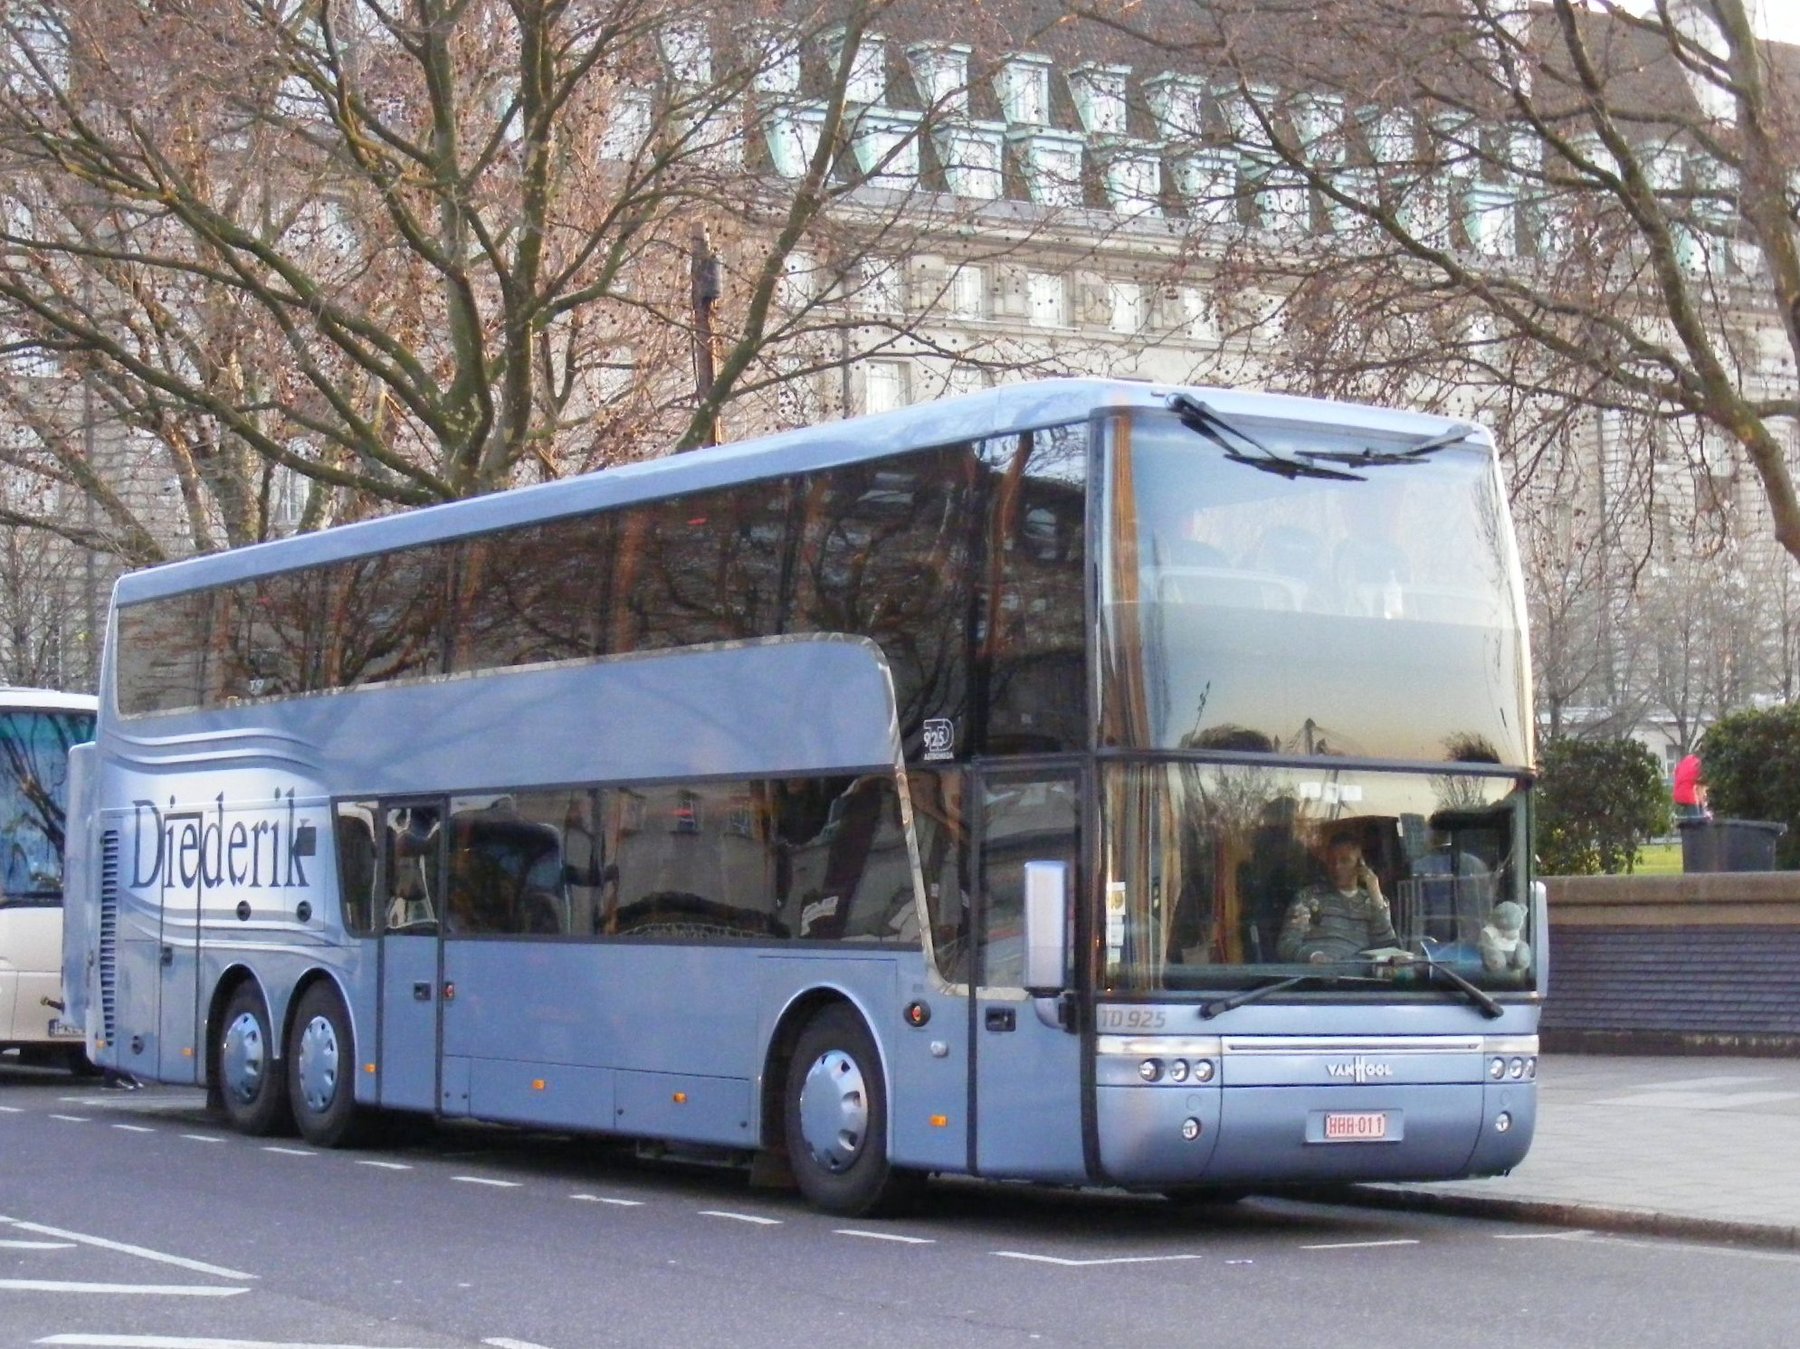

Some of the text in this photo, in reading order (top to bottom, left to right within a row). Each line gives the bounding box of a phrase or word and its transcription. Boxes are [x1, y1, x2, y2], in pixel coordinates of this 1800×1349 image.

[923, 731, 945, 747] 925
[129, 786, 310, 889] Diederik
[1102, 1009, 1167, 1029] TD 925
